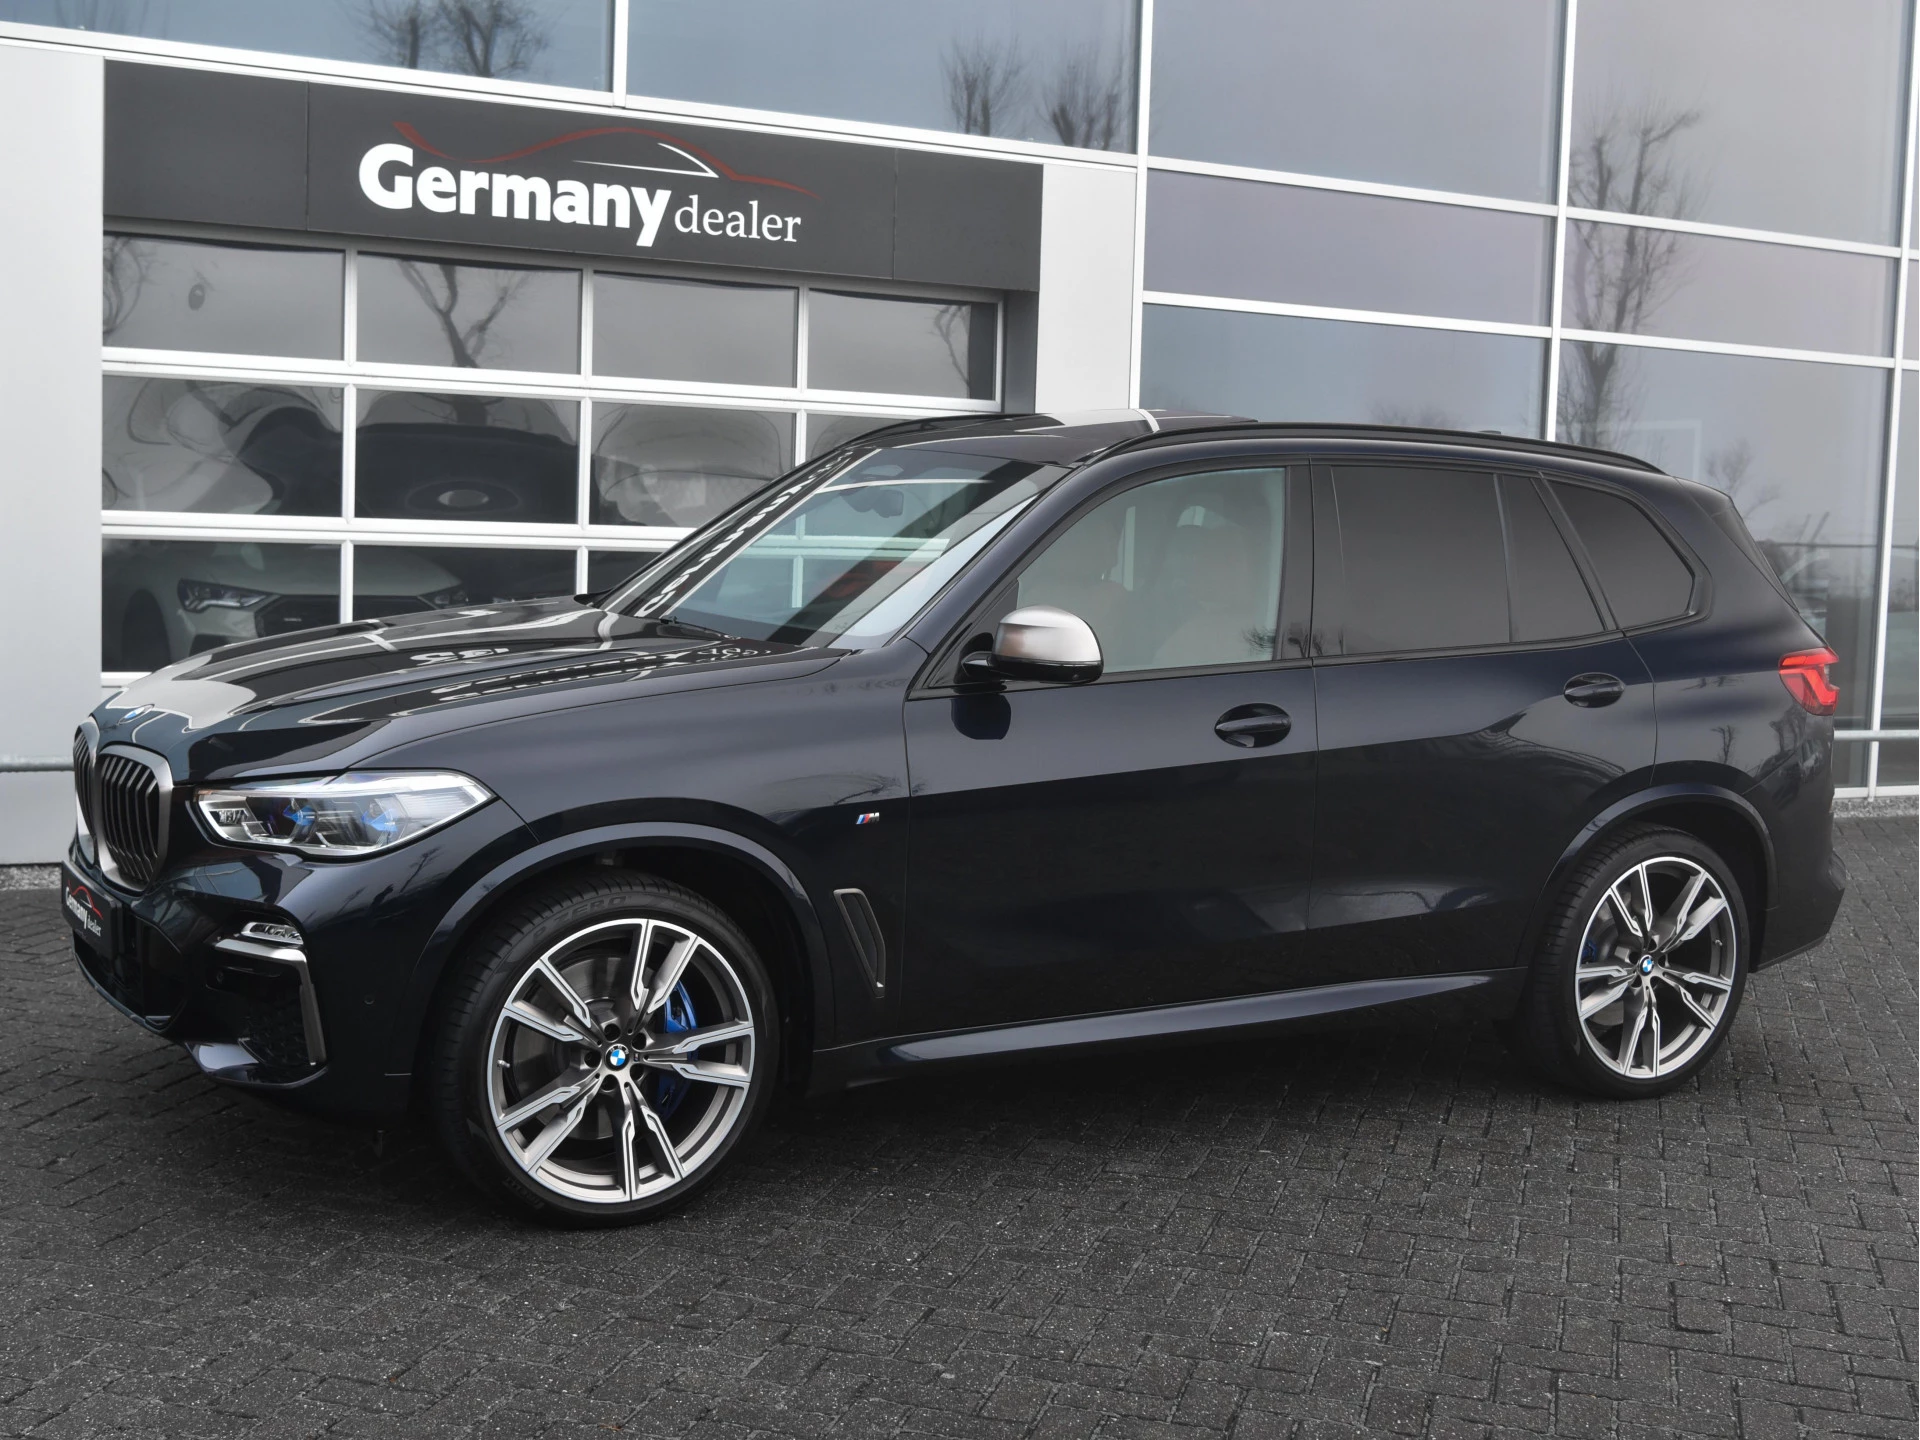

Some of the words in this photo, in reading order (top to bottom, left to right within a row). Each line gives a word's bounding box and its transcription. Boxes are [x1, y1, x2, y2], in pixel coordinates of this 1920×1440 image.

[358, 142, 672, 247] Germany
[674, 195, 801, 243] dealer
[553, 895, 628, 923] ZERO
